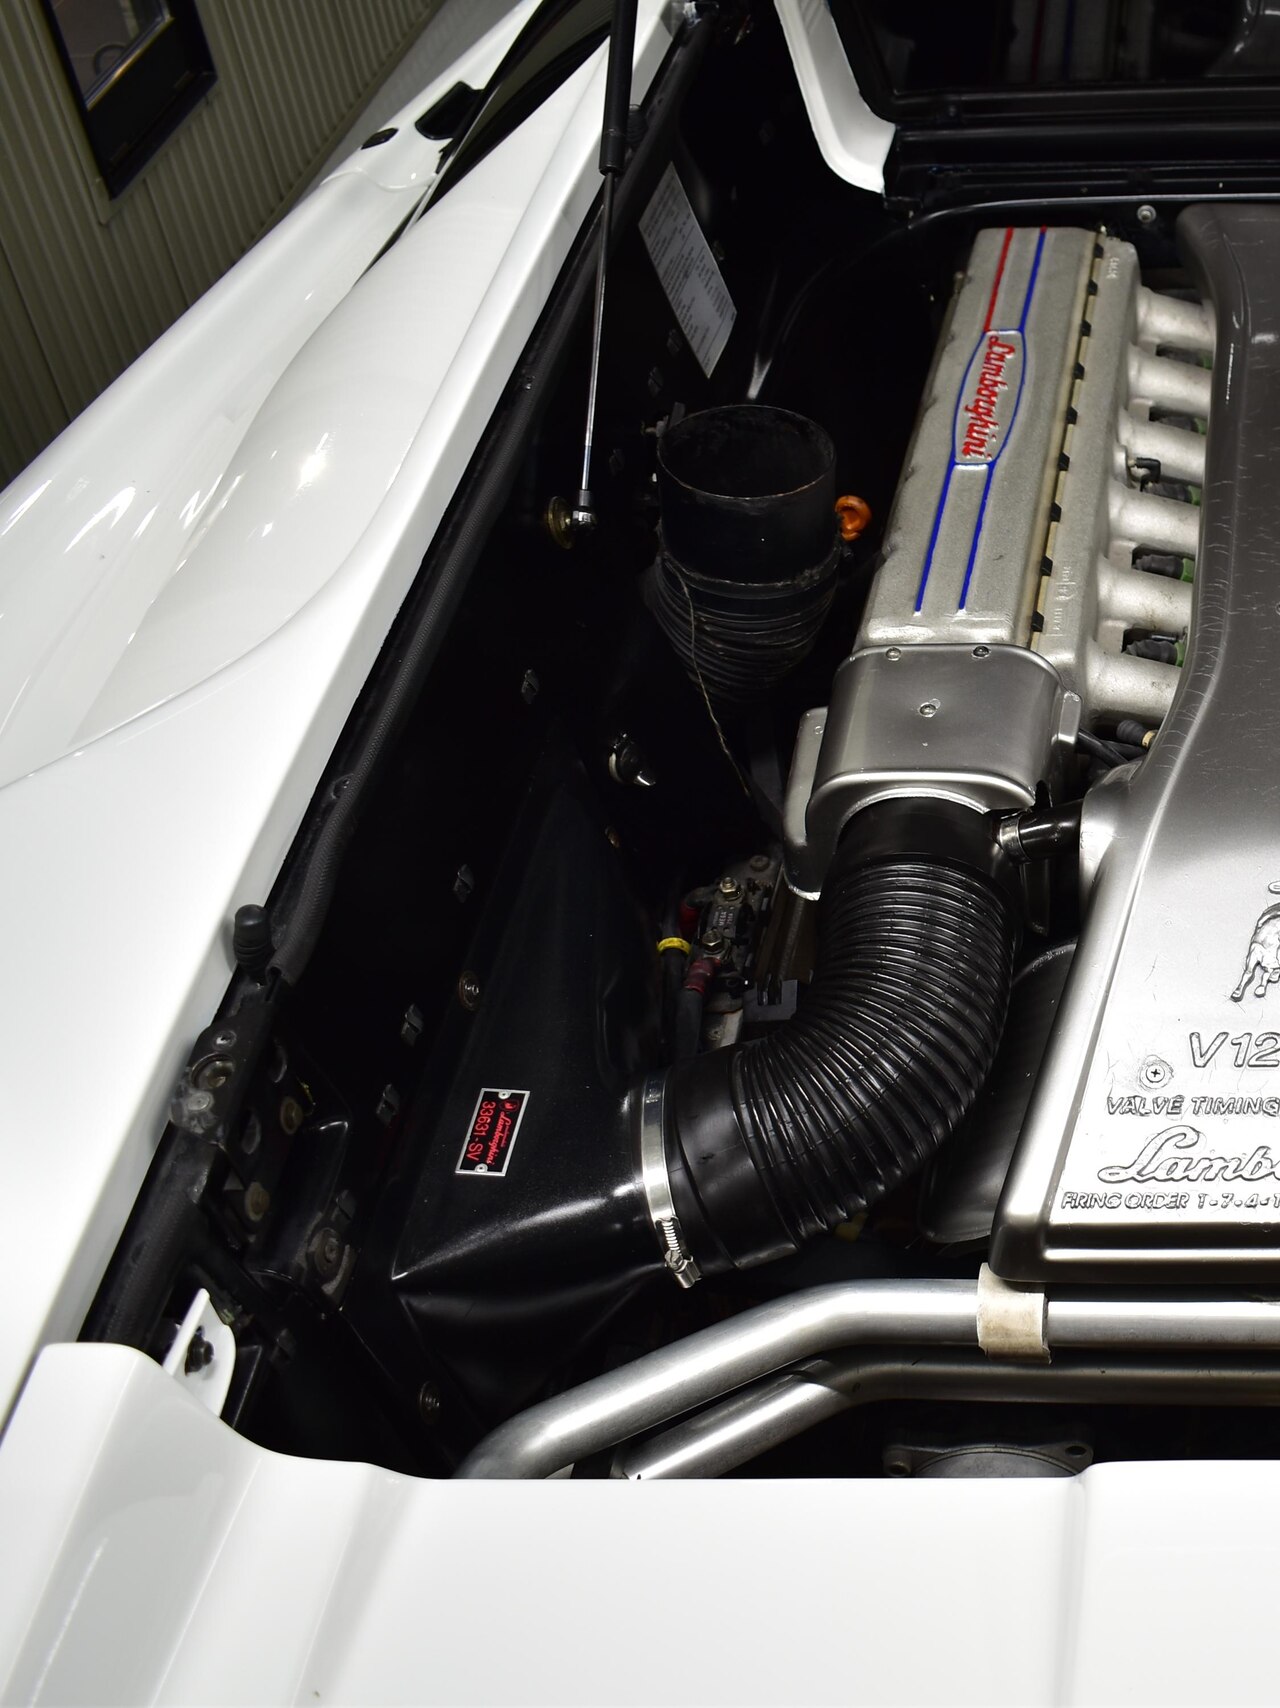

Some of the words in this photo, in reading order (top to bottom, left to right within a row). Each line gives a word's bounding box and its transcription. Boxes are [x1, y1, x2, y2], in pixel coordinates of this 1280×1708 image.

[962, 335, 1016, 461] Lamborghini
[1107, 1094, 1185, 1116] VALVE
[1191, 1095, 1280, 1116] TIMING
[466, 1100, 496, 1161] 33631-SV
[1061, 1191, 1122, 1210] FIRING
[1124, 1191, 1190, 1210] ORDER
